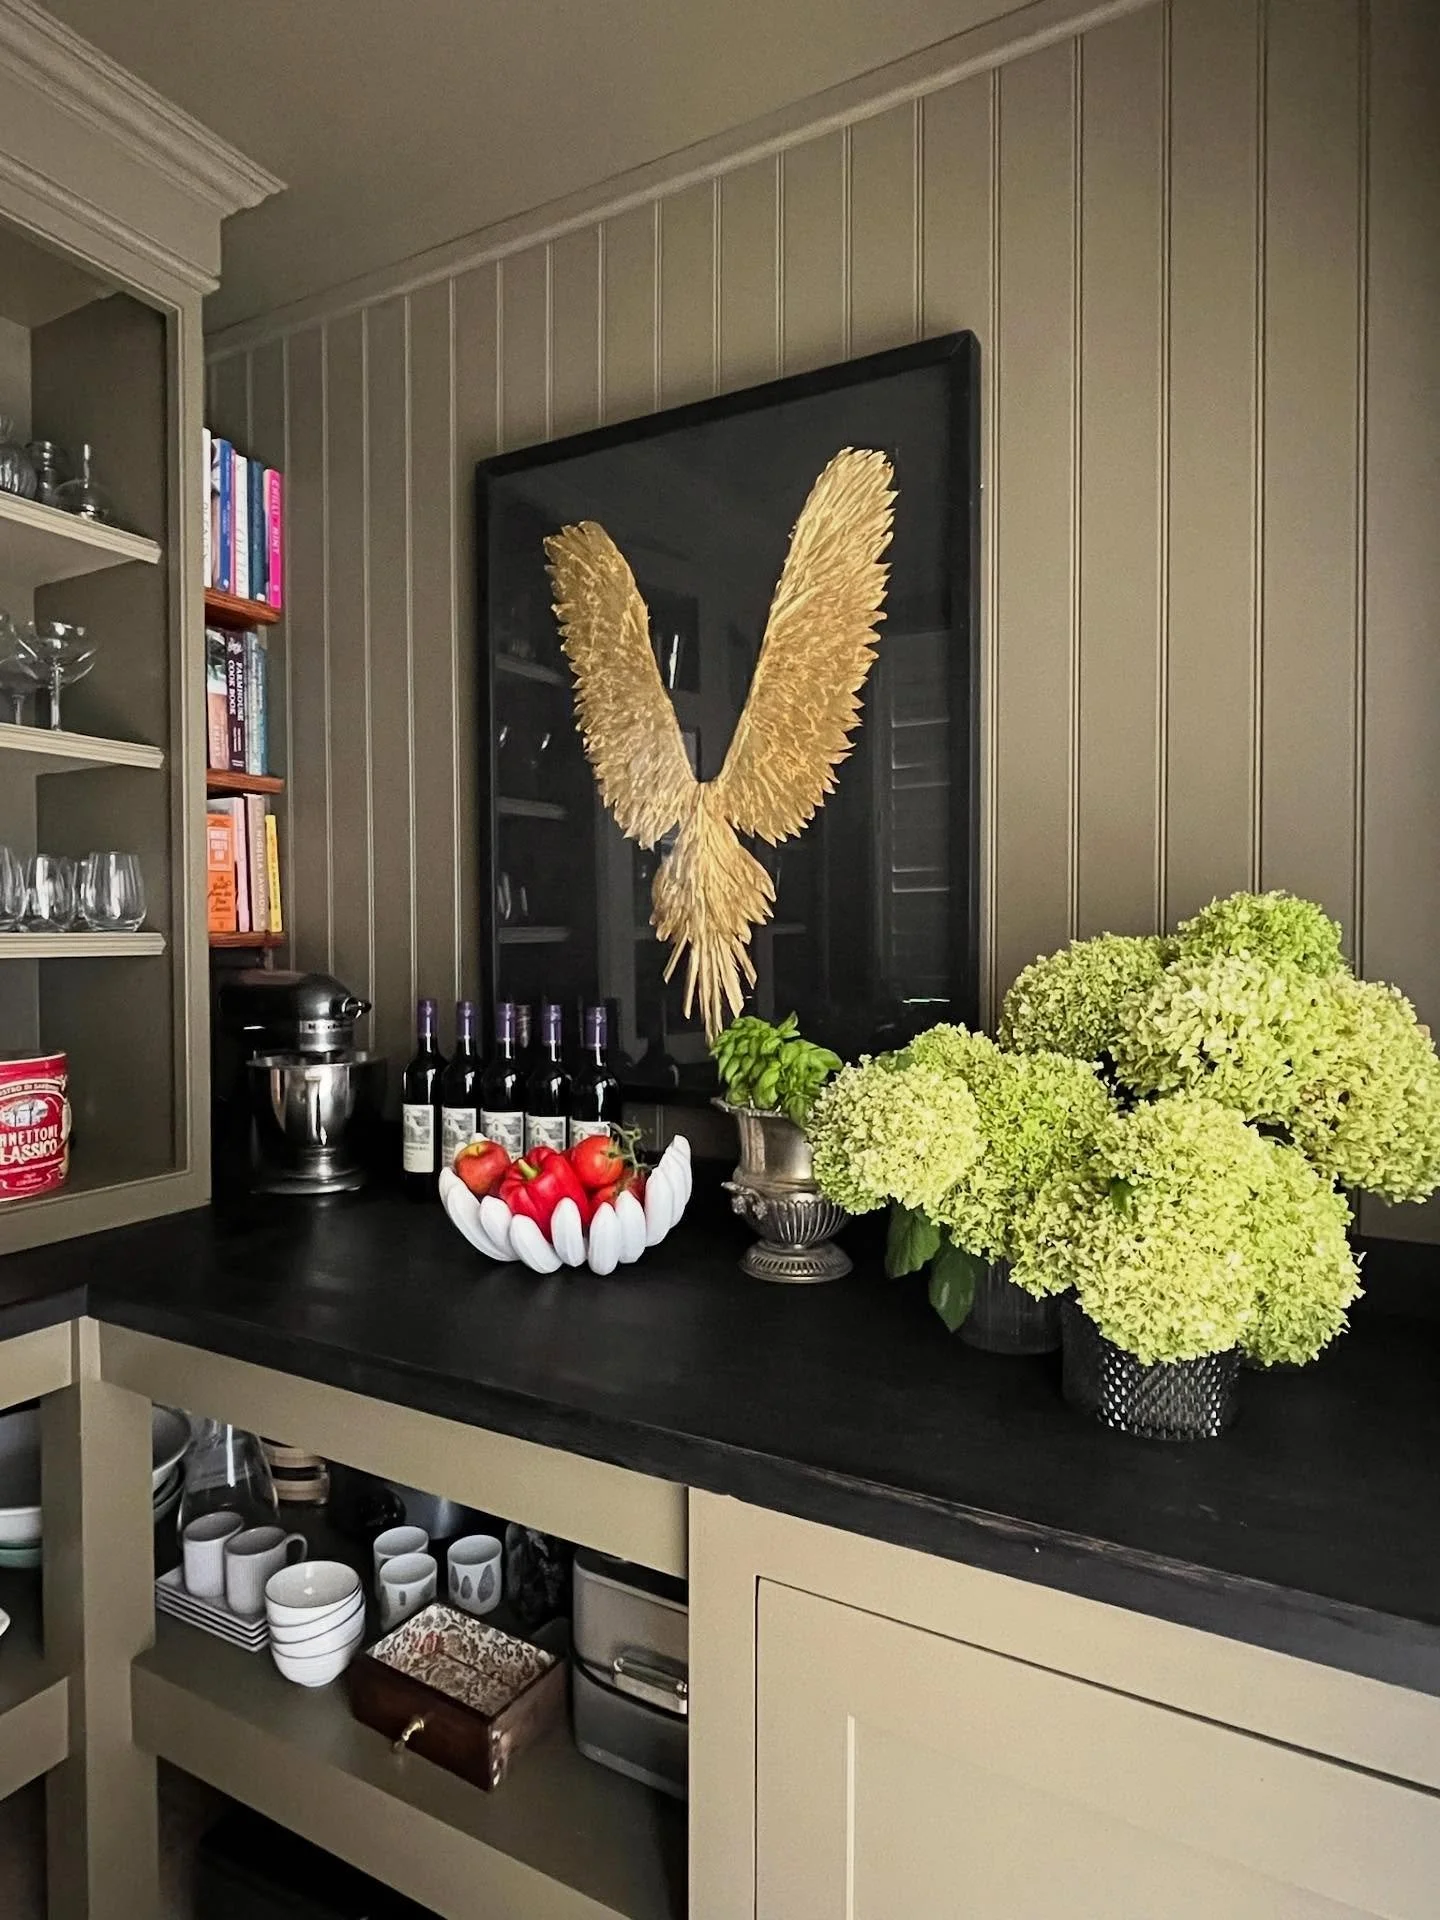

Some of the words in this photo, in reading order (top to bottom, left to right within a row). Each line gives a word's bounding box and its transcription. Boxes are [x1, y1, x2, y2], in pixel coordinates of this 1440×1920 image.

[271, 479, 281, 512] CHILLI
[272, 526, 281, 555] MINT
[227, 659, 236, 686] COOK
[229, 686, 237, 715] BOOK
[235, 661, 245, 722] FARMHOUSE
[255, 829, 265, 870] NIGELLA
[257, 872, 266, 916] LAWSON
[0, 1138, 58, 1164] LASSICO
